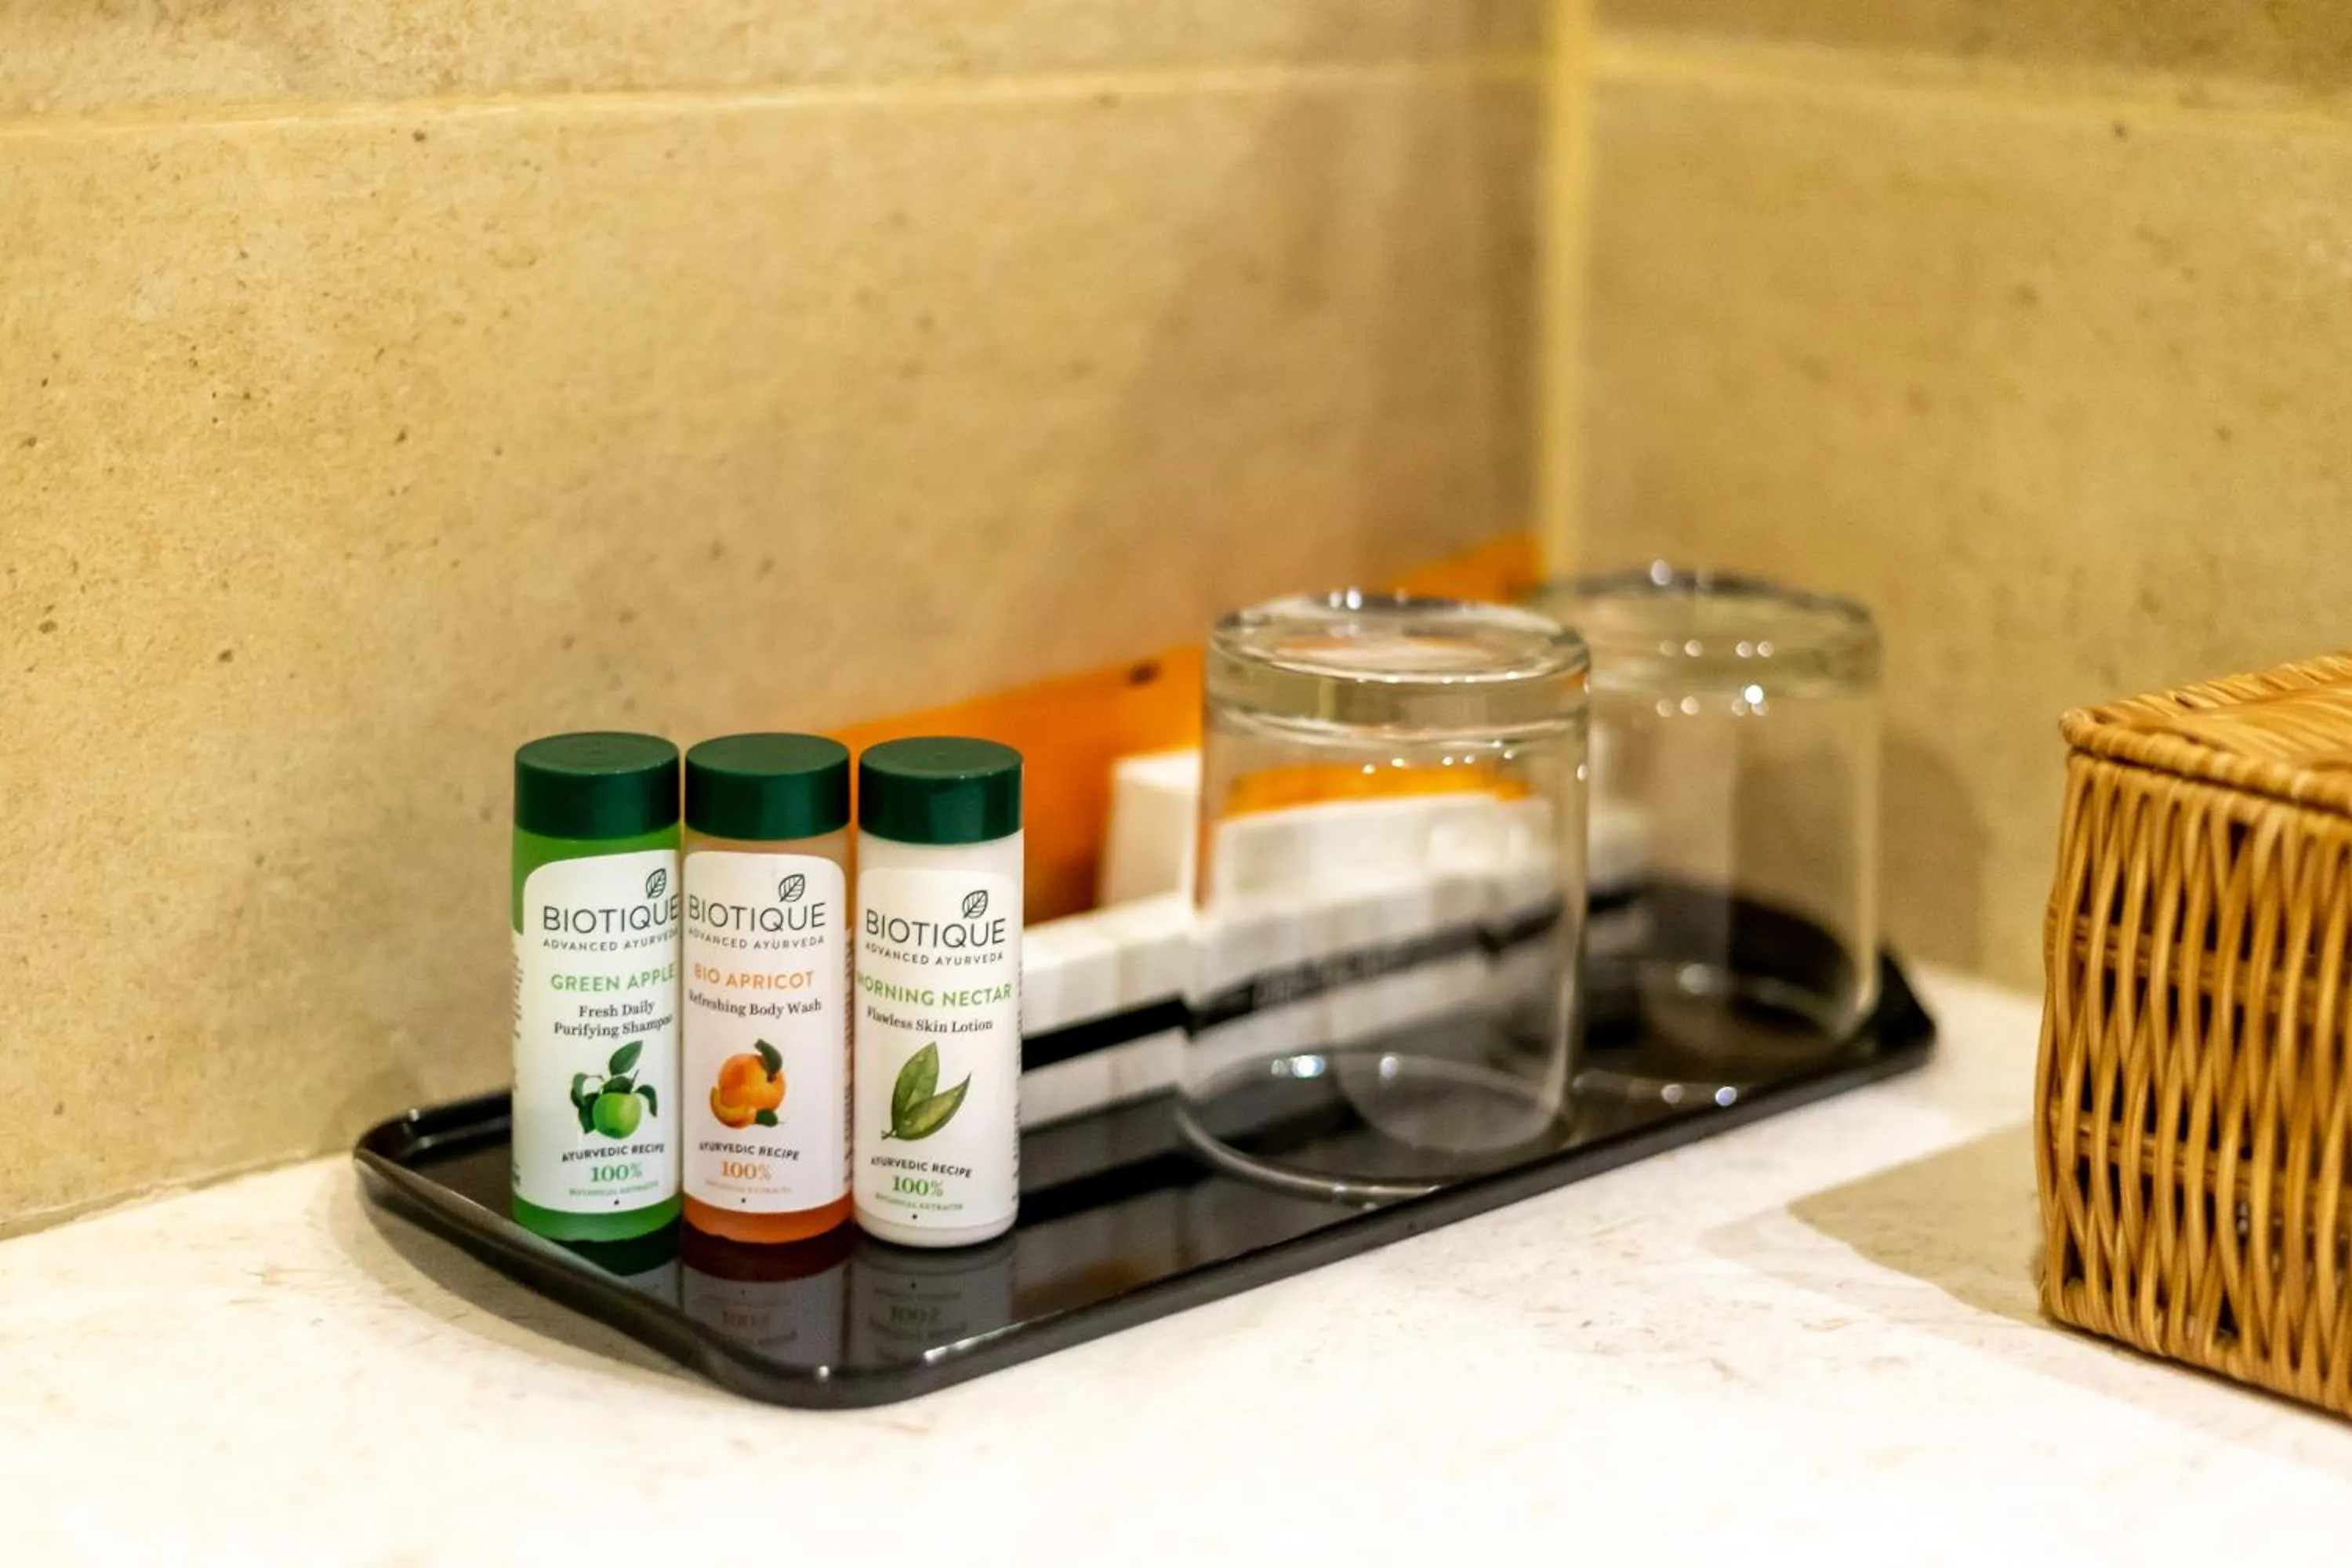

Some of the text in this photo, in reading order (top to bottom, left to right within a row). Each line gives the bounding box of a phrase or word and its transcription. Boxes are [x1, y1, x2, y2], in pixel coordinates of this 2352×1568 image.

[543, 894, 679, 934] BIOTIQUE
[688, 894, 826, 932] BIOTIQUE
[688, 927, 825, 950] ADVANCED AYURVEDA
[866, 908, 1006, 948] BIOTIQUE
[543, 938, 618, 952] ADVANCED
[865, 942, 1004, 966] ADVANCED AYURVEDA
[551, 963, 677, 992] GREEN APPLE
[694, 963, 815, 989] BIO APRICOT
[942, 983, 1012, 1007] NECTAR
[579, 1000, 656, 1018] Fresh Daily
[750, 1003, 784, 1019] Body
[787, 998, 822, 1014] Wash
[866, 1005, 993, 1033] Flawless Skin Lotion
[554, 1021, 619, 1039] Purifying
[562, 1142, 666, 1163] AYURVEDIC RECIPE
[699, 1141, 800, 1161] AYURVEDIC RECIPE
[590, 1162, 643, 1182] 100%
[721, 1160, 772, 1181] 100%
[870, 1156, 973, 1178] AYURVEDIC RECIPE
[892, 1175, 943, 1196] 100%
